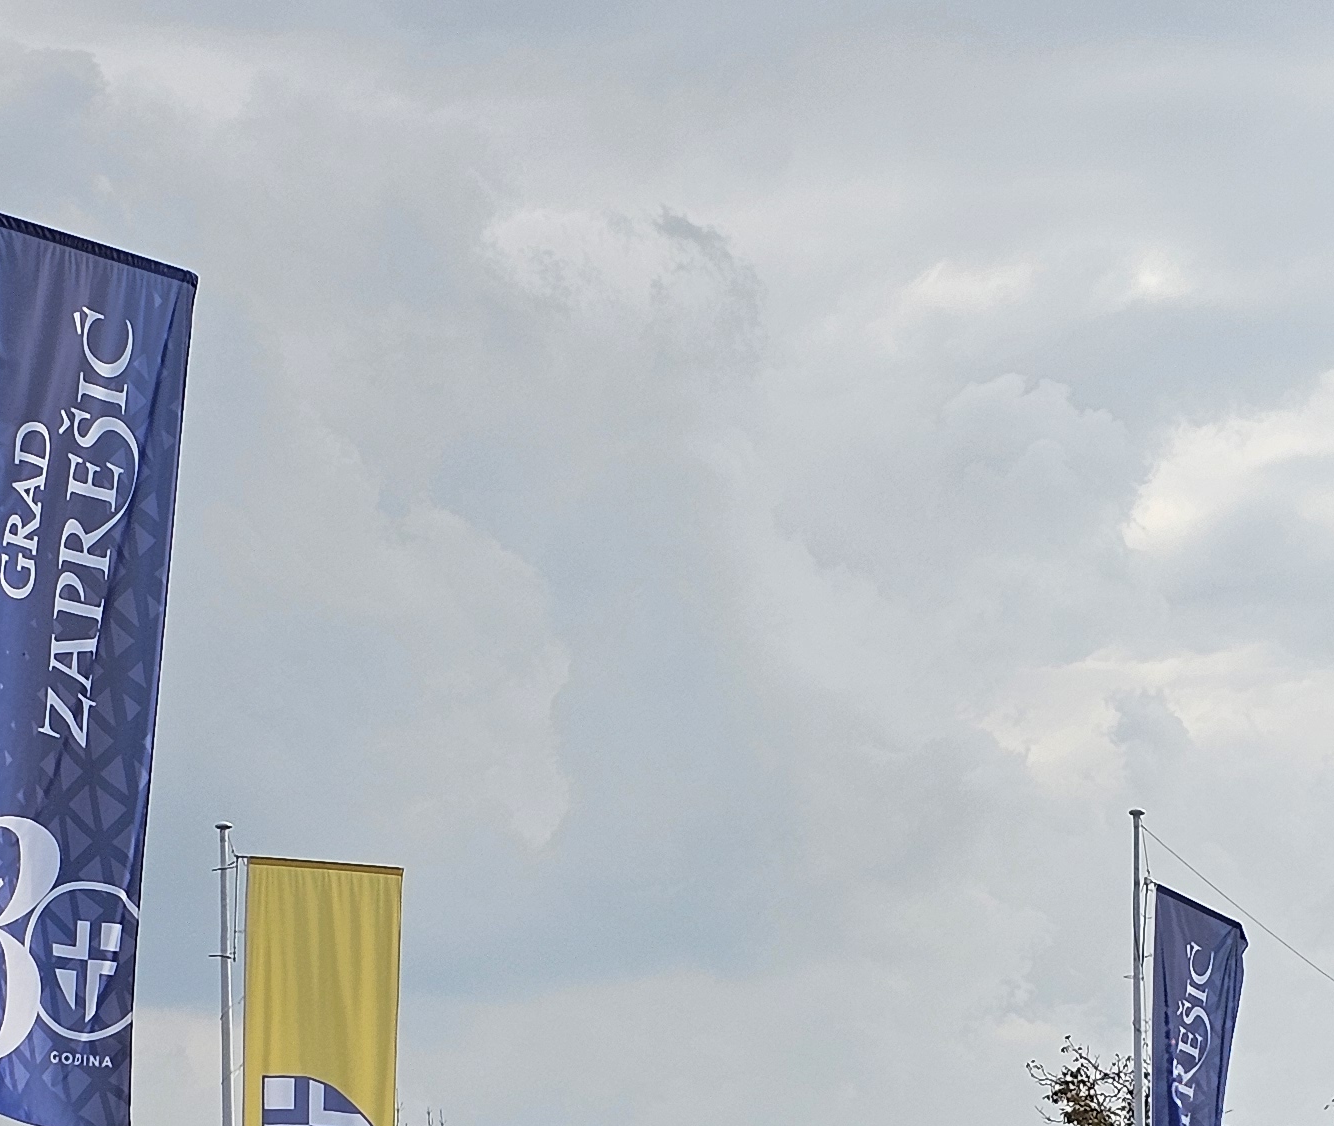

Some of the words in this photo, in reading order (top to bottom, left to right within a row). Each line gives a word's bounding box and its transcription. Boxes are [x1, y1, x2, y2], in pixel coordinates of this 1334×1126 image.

[0, 421, 51, 599] GRAD
[38, 306, 139, 749] ZAPREŠIĆ
[49, 1050, 113, 1069] GODINA
